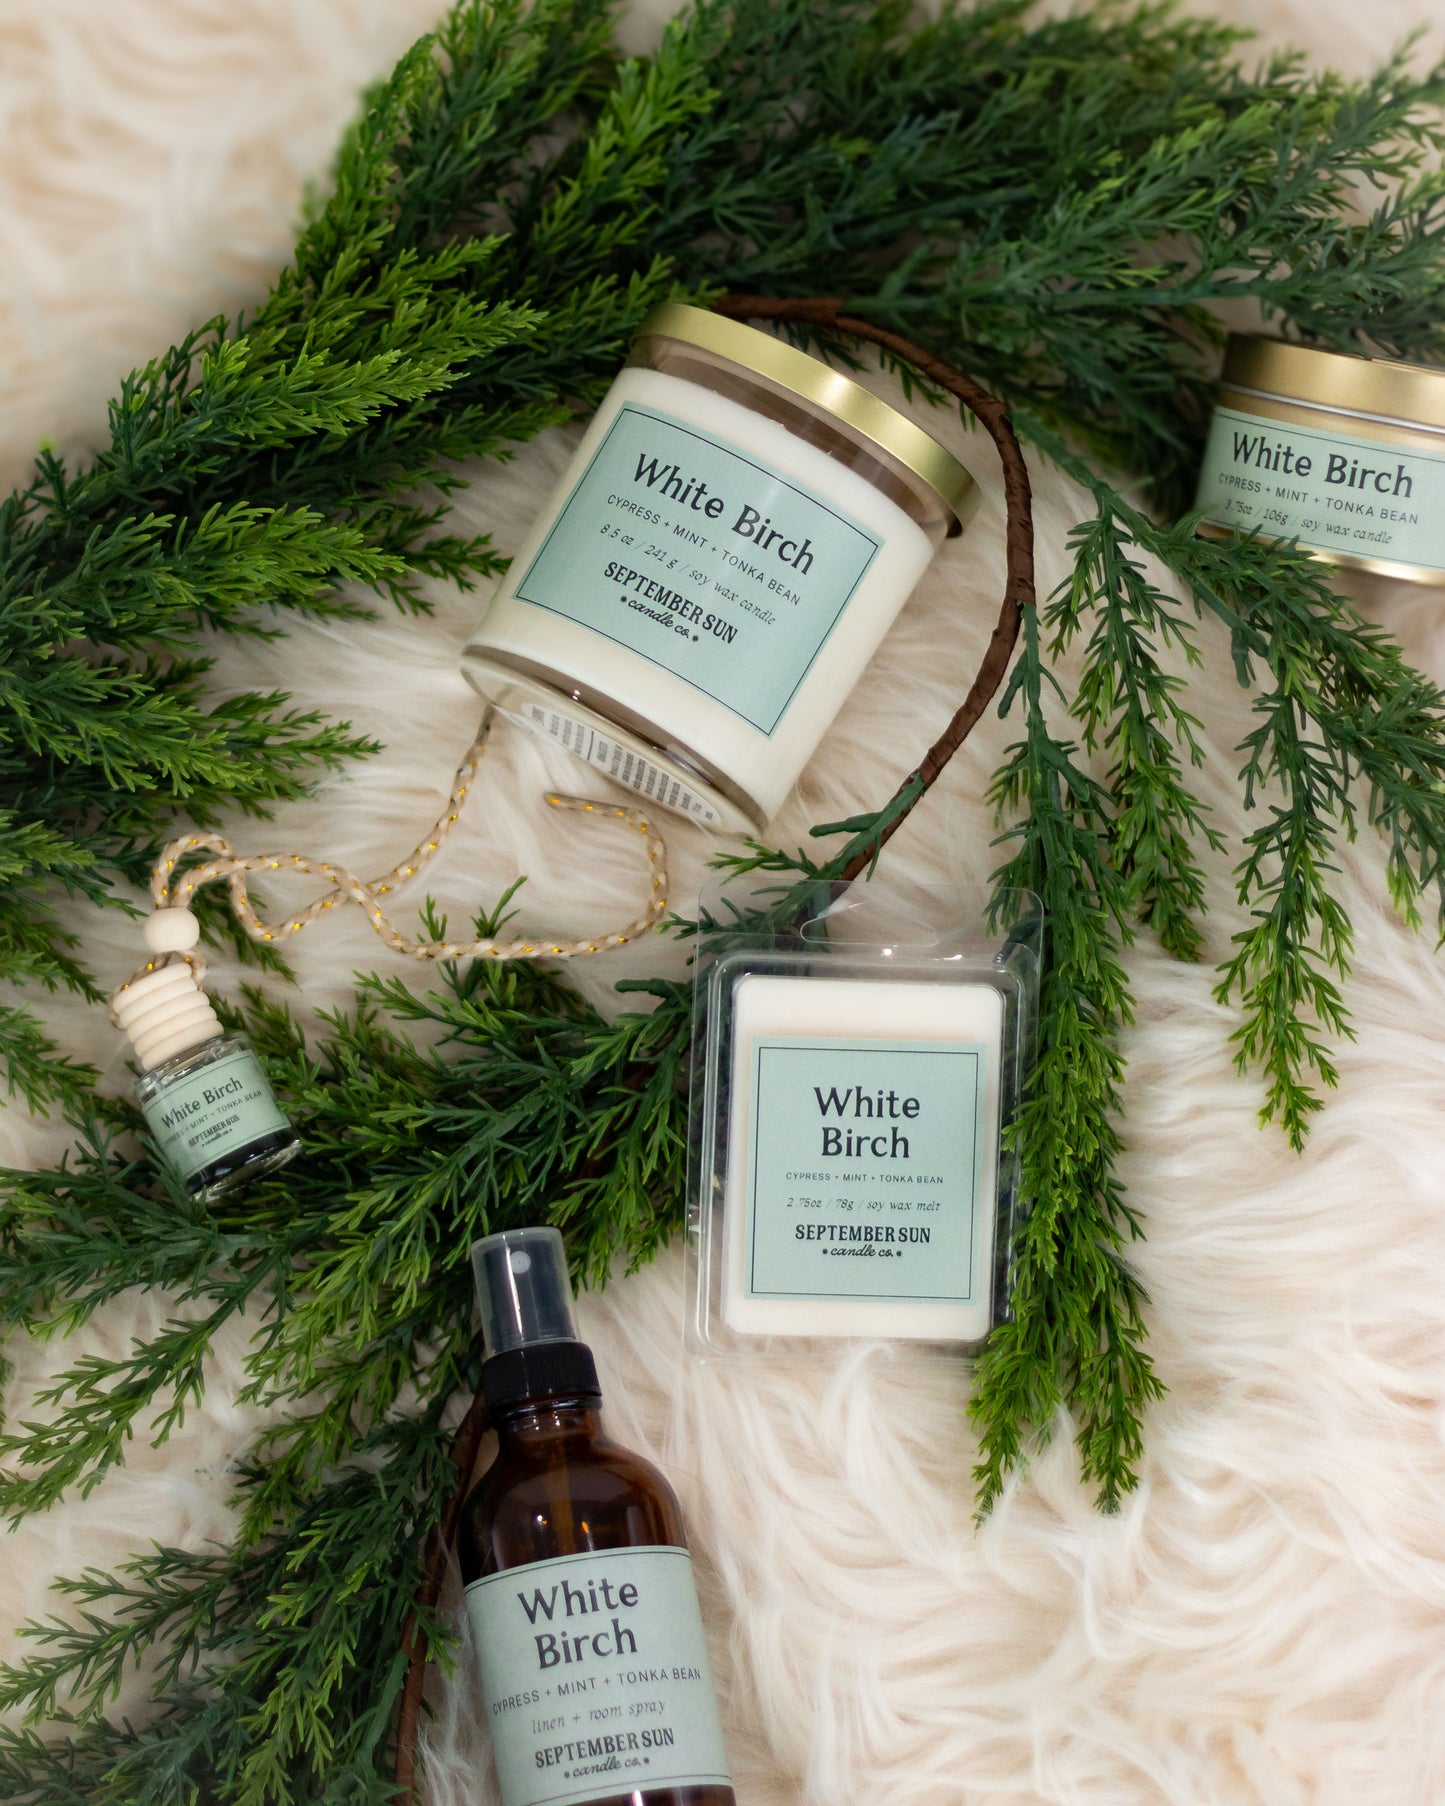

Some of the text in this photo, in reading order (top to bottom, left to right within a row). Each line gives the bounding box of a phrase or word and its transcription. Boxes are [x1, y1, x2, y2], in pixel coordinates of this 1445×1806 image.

[1233, 432, 1413, 498] White Birch
[633, 453, 814, 575] White Birch
[1219, 473, 1261, 493] CYPRESS
[1275, 487, 1309, 503] MINT
[1326, 498, 1375, 517] TONKA
[1380, 509, 1419, 524] BEAN
[1263, 508, 1289, 525] 106g
[1301, 518, 1321, 532] soy
[1326, 523, 1350, 536] wax
[1353, 527, 1393, 544] candle
[608, 494, 660, 525] CYPRESS
[673, 524, 708, 549] MINT
[722, 550, 764, 584] TONKA
[768, 579, 801, 606] BEAN
[600, 523, 619, 540] 8.5
[620, 535, 635, 546] oz
[644, 544, 667, 563] 241
[667, 558, 678, 570] g
[689, 568, 710, 586] soy
[714, 582, 739, 602] wax
[740, 598, 776, 626] candle
[604, 561, 738, 644] SEPTEMBER SUN
[628, 598, 673, 628] candle
[161, 1077, 243, 1129] White Birch
[191, 1116, 209, 1129] MINT
[217, 1099, 243, 1114] TONKA
[244, 1089, 263, 1101] BEAN
[813, 1086, 920, 1119] White
[188, 1121, 226, 1147] SEPTEMBER
[822, 1127, 910, 1158] Birch
[786, 1172, 831, 1181] CYPRESS
[843, 1173, 867, 1182] MINT
[879, 1174, 913, 1183] TONKA
[917, 1175, 944, 1184] BEAN
[787, 1198, 822, 1208] 2.75oz
[836, 1198, 854, 1211] 78g
[867, 1201, 884, 1212] soy
[890, 1201, 912, 1211] wax
[916, 1201, 941, 1211] melt
[795, 1224, 931, 1243] SEPTEMBER SUN
[830, 1244, 876, 1257] candle
[517, 1578, 639, 1625] White
[534, 1618, 638, 1669] Birch
[493, 1690, 539, 1715] CYPRESS
[558, 1677, 597, 1697] MINT
[617, 1668, 668, 1685] TONKA
[673, 1667, 701, 1680] BEAN
[532, 1716, 566, 1734] linen
[589, 1707, 623, 1722] room
[628, 1700, 666, 1718] spray
[535, 1728, 675, 1768] SEPTEMBER SUN
[573, 1755, 622, 1778] candle
